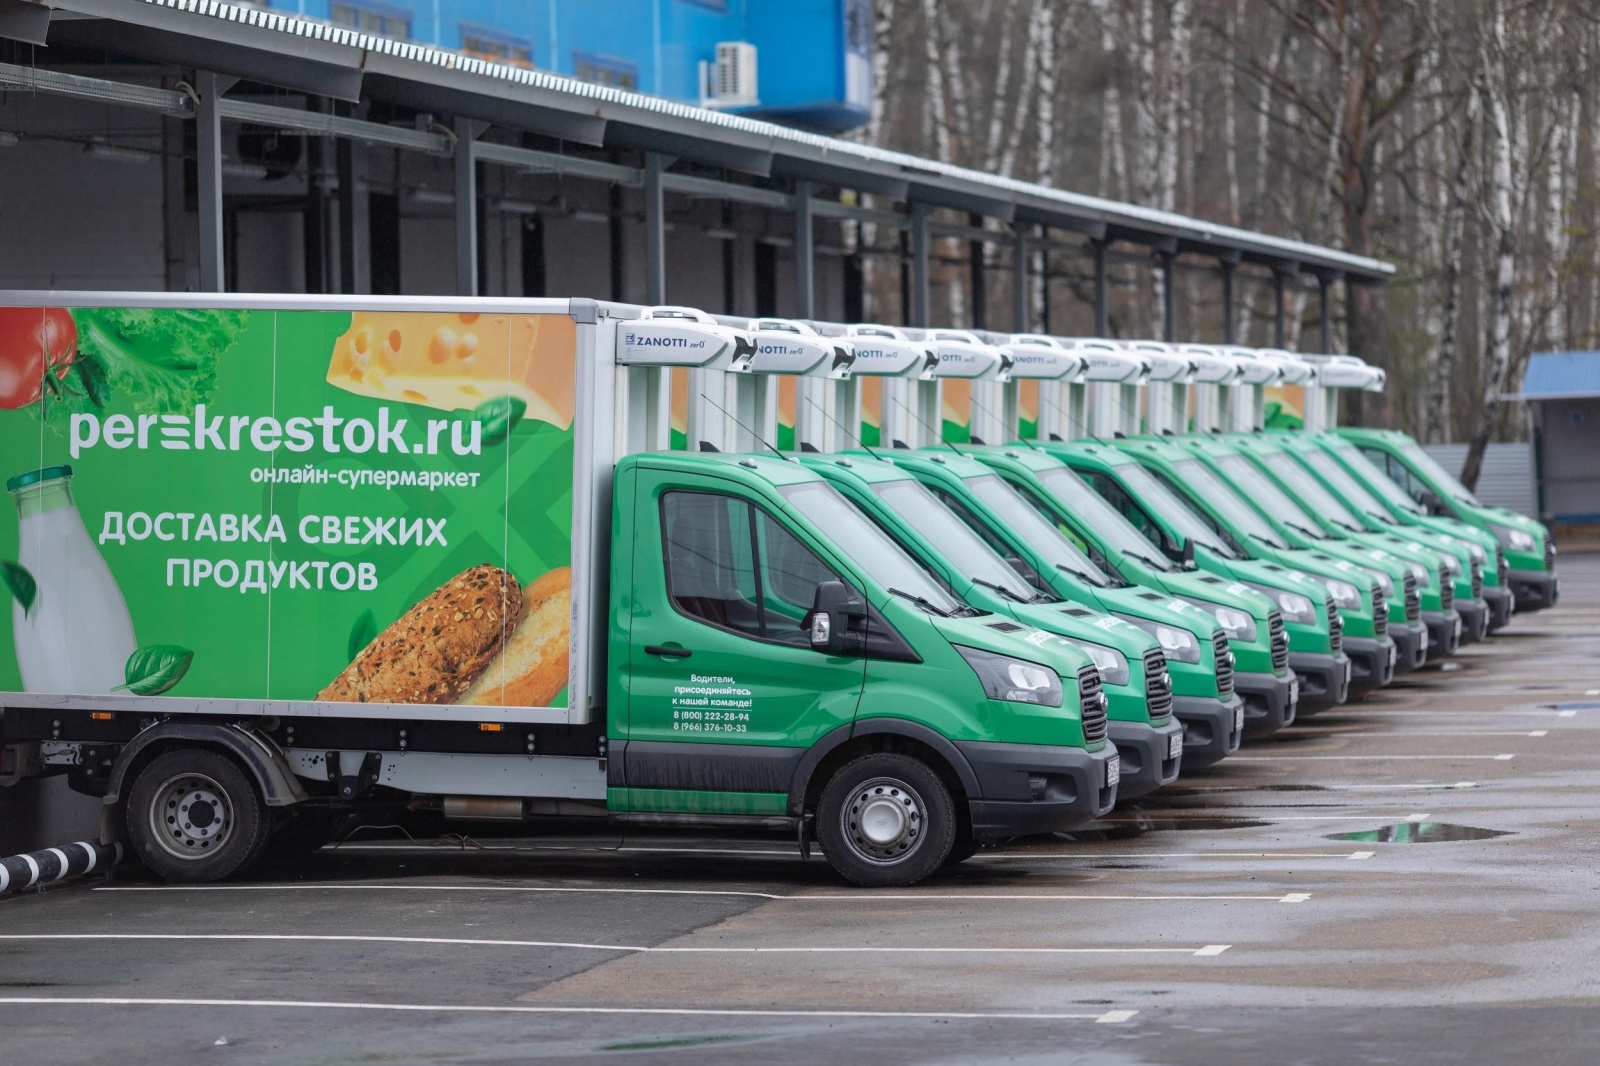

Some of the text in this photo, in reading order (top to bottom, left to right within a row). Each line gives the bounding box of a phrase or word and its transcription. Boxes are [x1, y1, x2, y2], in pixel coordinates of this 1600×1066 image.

[636, 336, 687, 348] ZANOTTI
[758, 345, 787, 355] NOTTI
[856, 349, 883, 358] NOTTI
[1014, 356, 1044, 364] ANOTTI
[69, 405, 482, 459] perekrestok.ru
[250, 464, 480, 490] онлайн-супермаркет
[98, 511, 448, 547] ДОСТАВКА СВЕЖИХ
[166, 558, 378, 594] ПРОДУКТОВ
[690, 673, 736, 685] Водители,
[674, 686, 752, 696] присоединяйтесь
[680, 697, 708, 706] нашей
[710, 699, 752, 708] команде!
[673, 711, 749, 721] 8 (800) 222-28-94
[673, 722, 747, 733] 8 (966) 376-10-33
